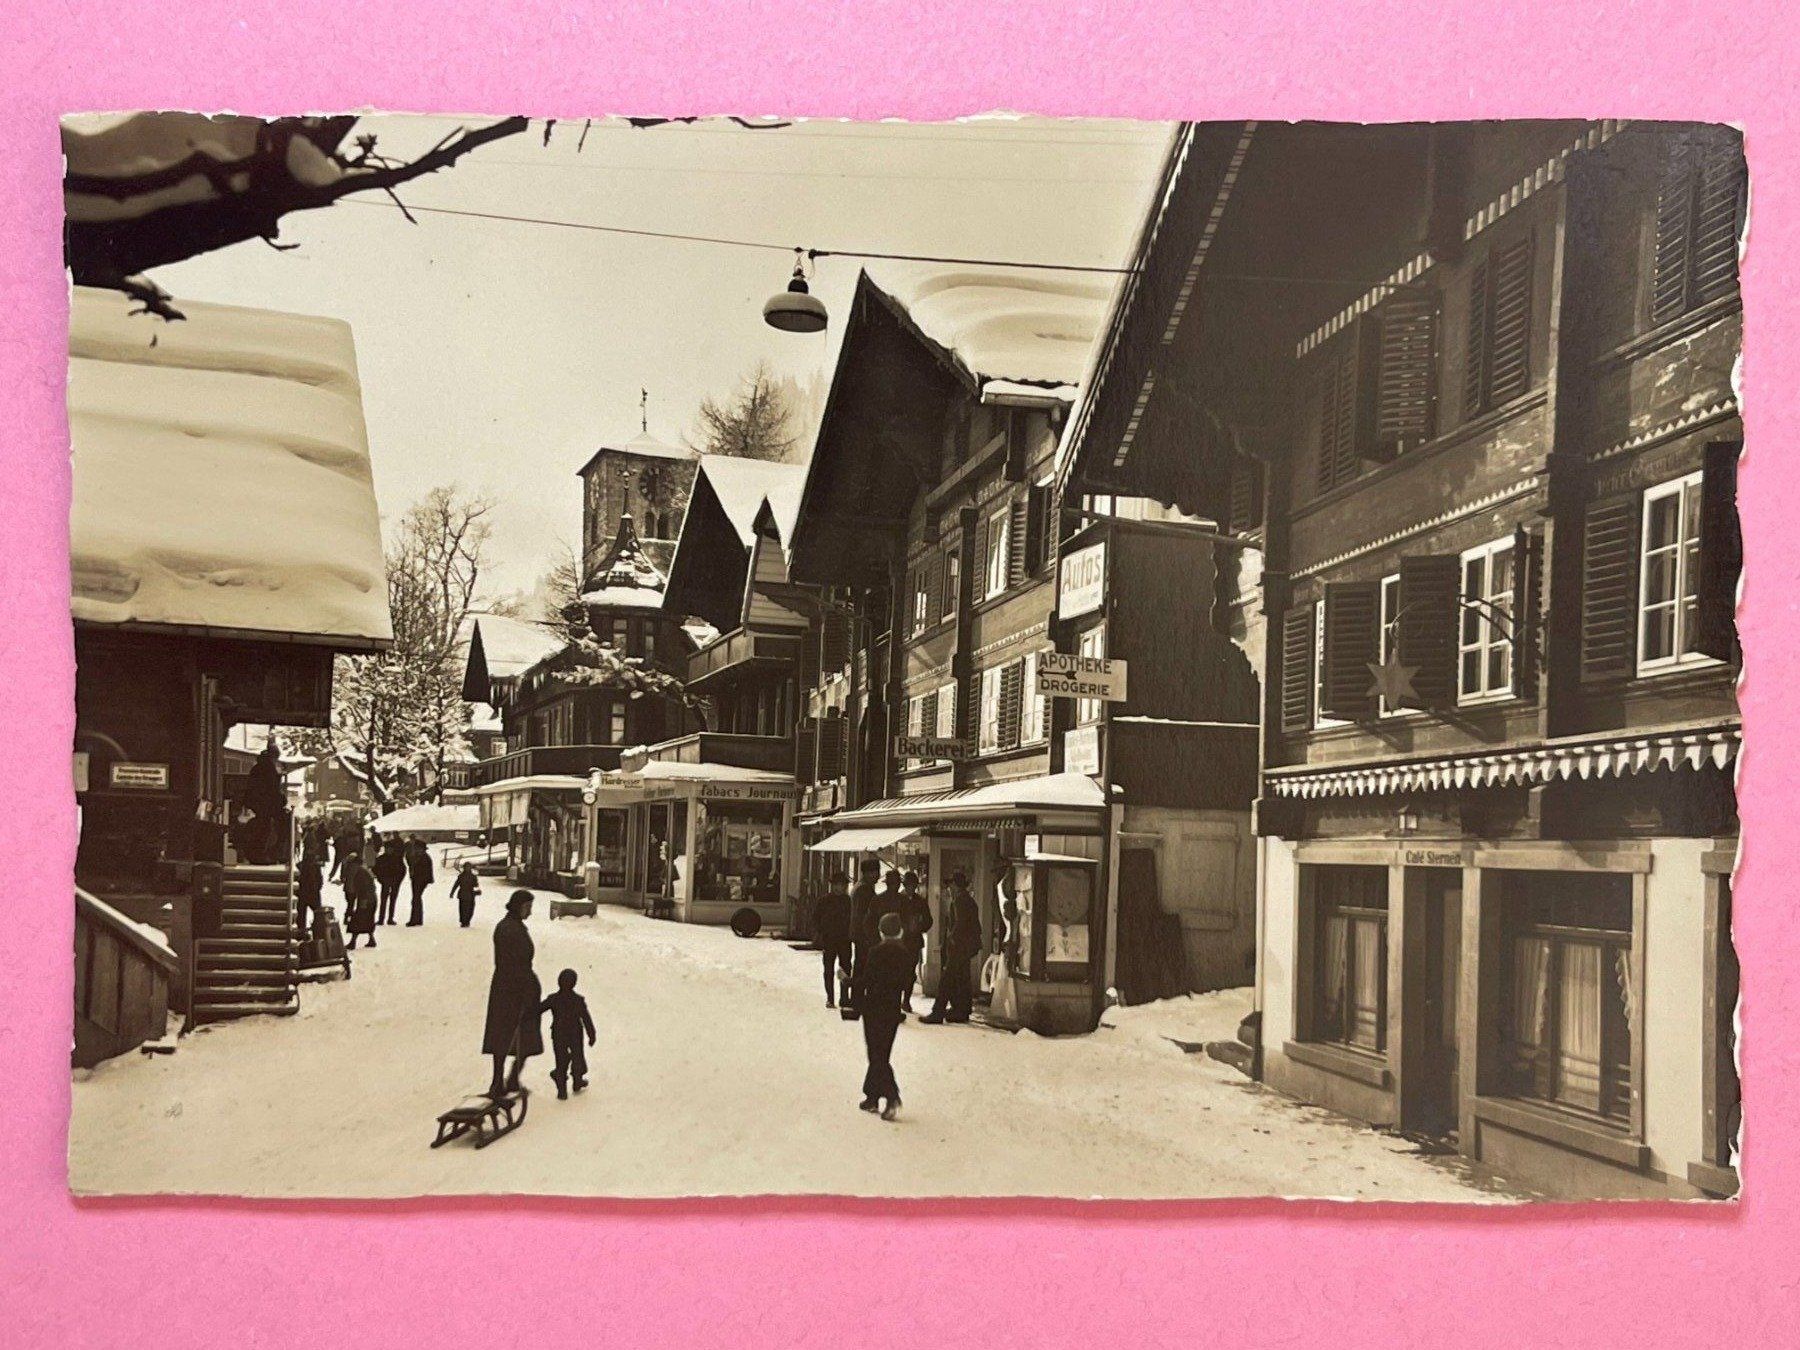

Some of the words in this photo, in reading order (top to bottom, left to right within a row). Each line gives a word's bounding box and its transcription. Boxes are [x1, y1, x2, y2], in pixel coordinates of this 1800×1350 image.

[1062, 552, 1102, 594] Autos
[1039, 652, 1112, 674] APOTHEKE
[1040, 678, 1109, 696] DROGERIE
[701, 784, 741, 798] Tabacs
[1405, 850, 1424, 864] Café
